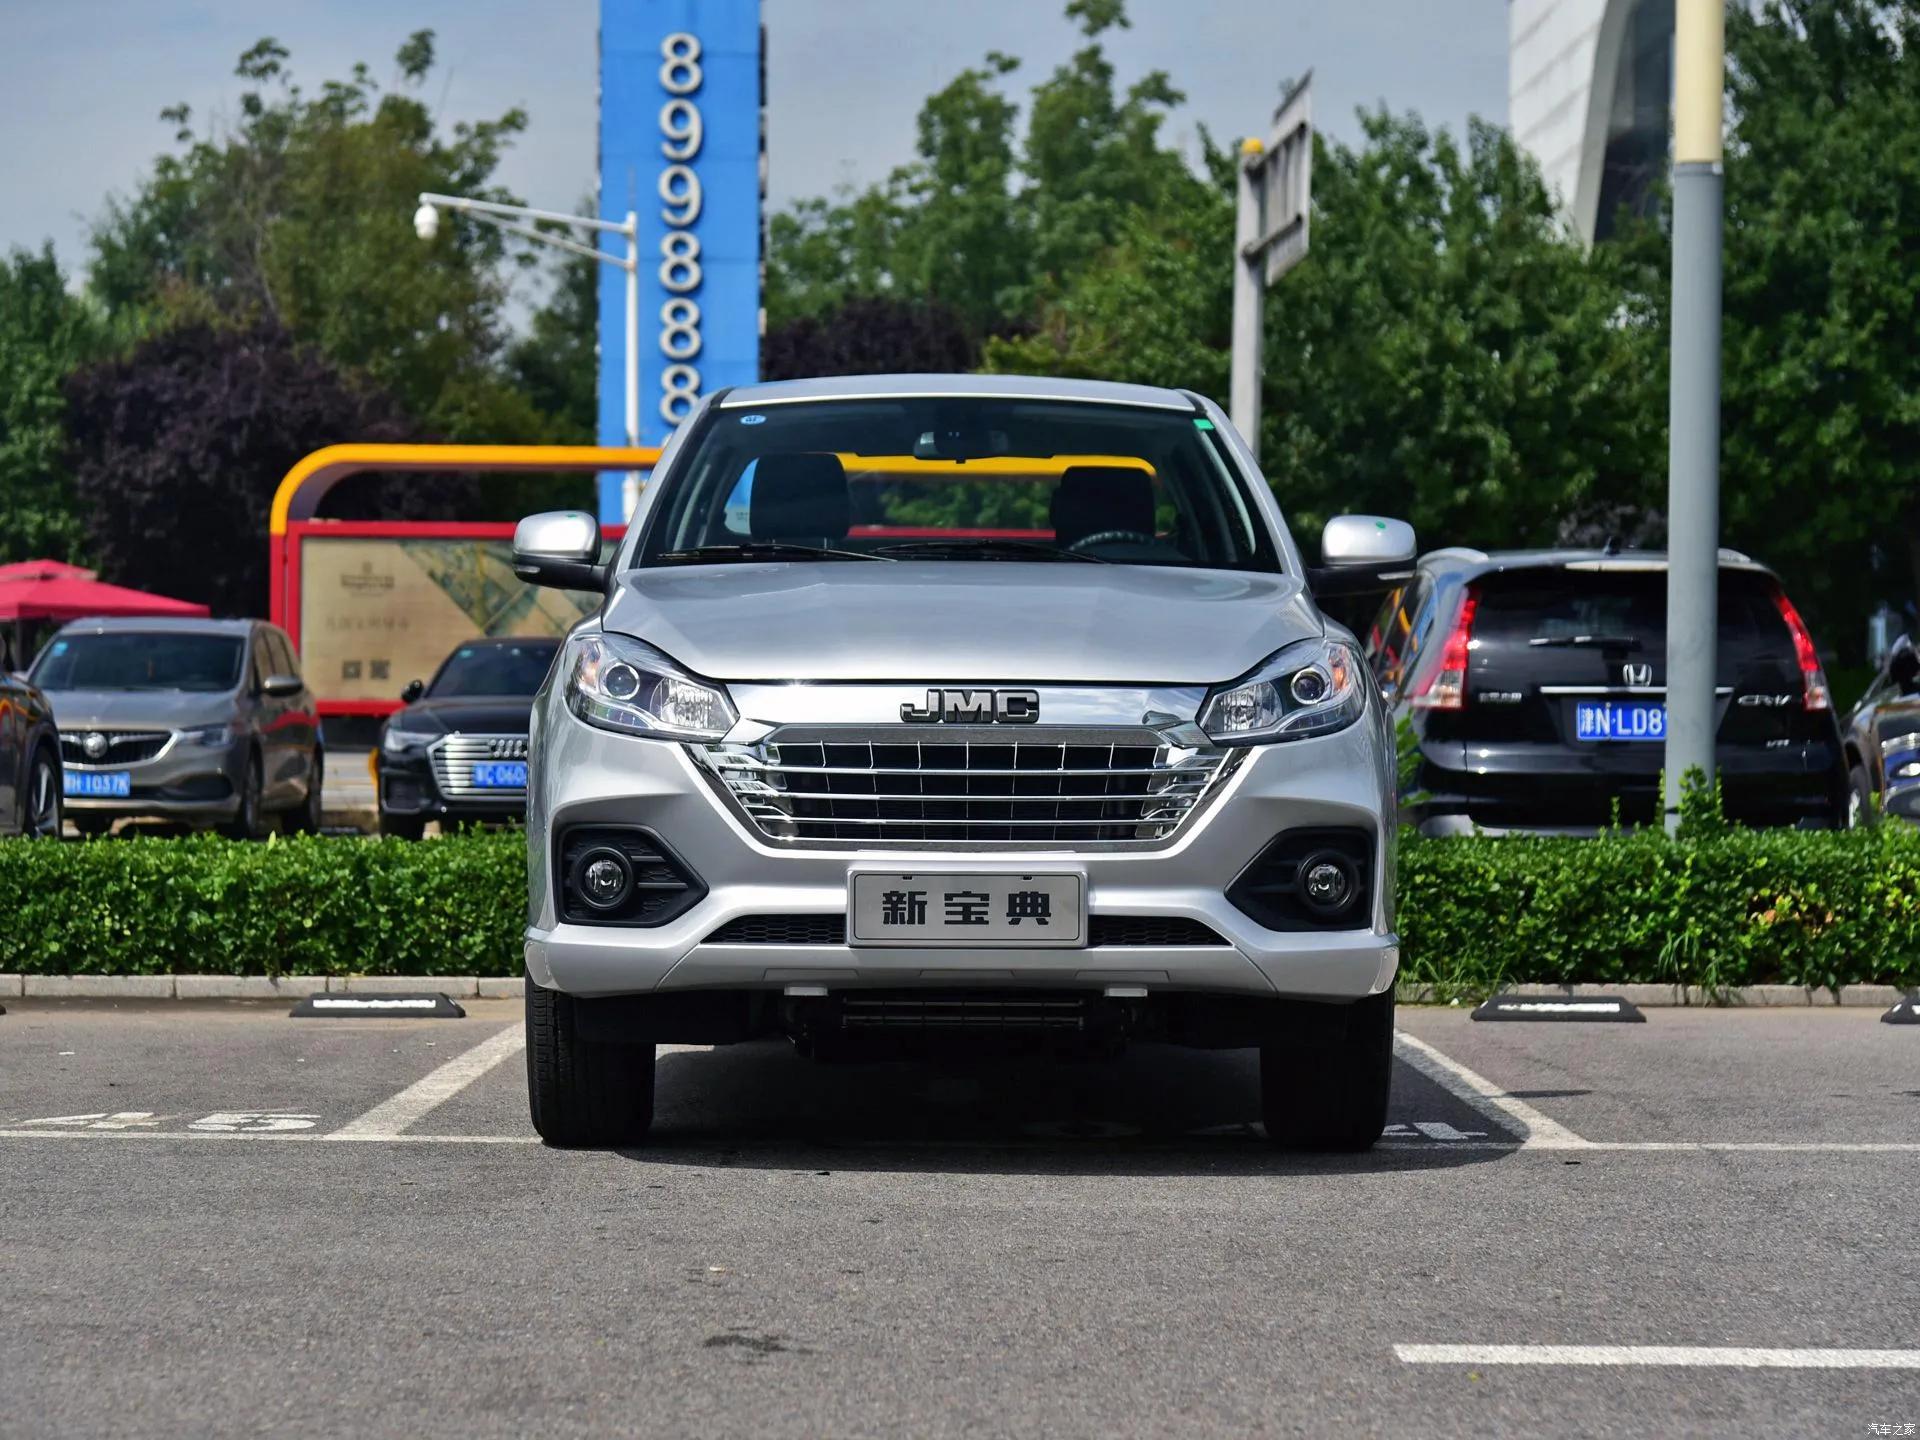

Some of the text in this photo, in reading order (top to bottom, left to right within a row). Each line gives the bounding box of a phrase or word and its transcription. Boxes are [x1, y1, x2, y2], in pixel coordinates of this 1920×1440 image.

[658, 32, 703, 446] 899888
[899, 688, 1040, 724] JMC
[1580, 707, 1667, 736] 津N·LD8
[882, 890, 1052, 926] 新宝典
